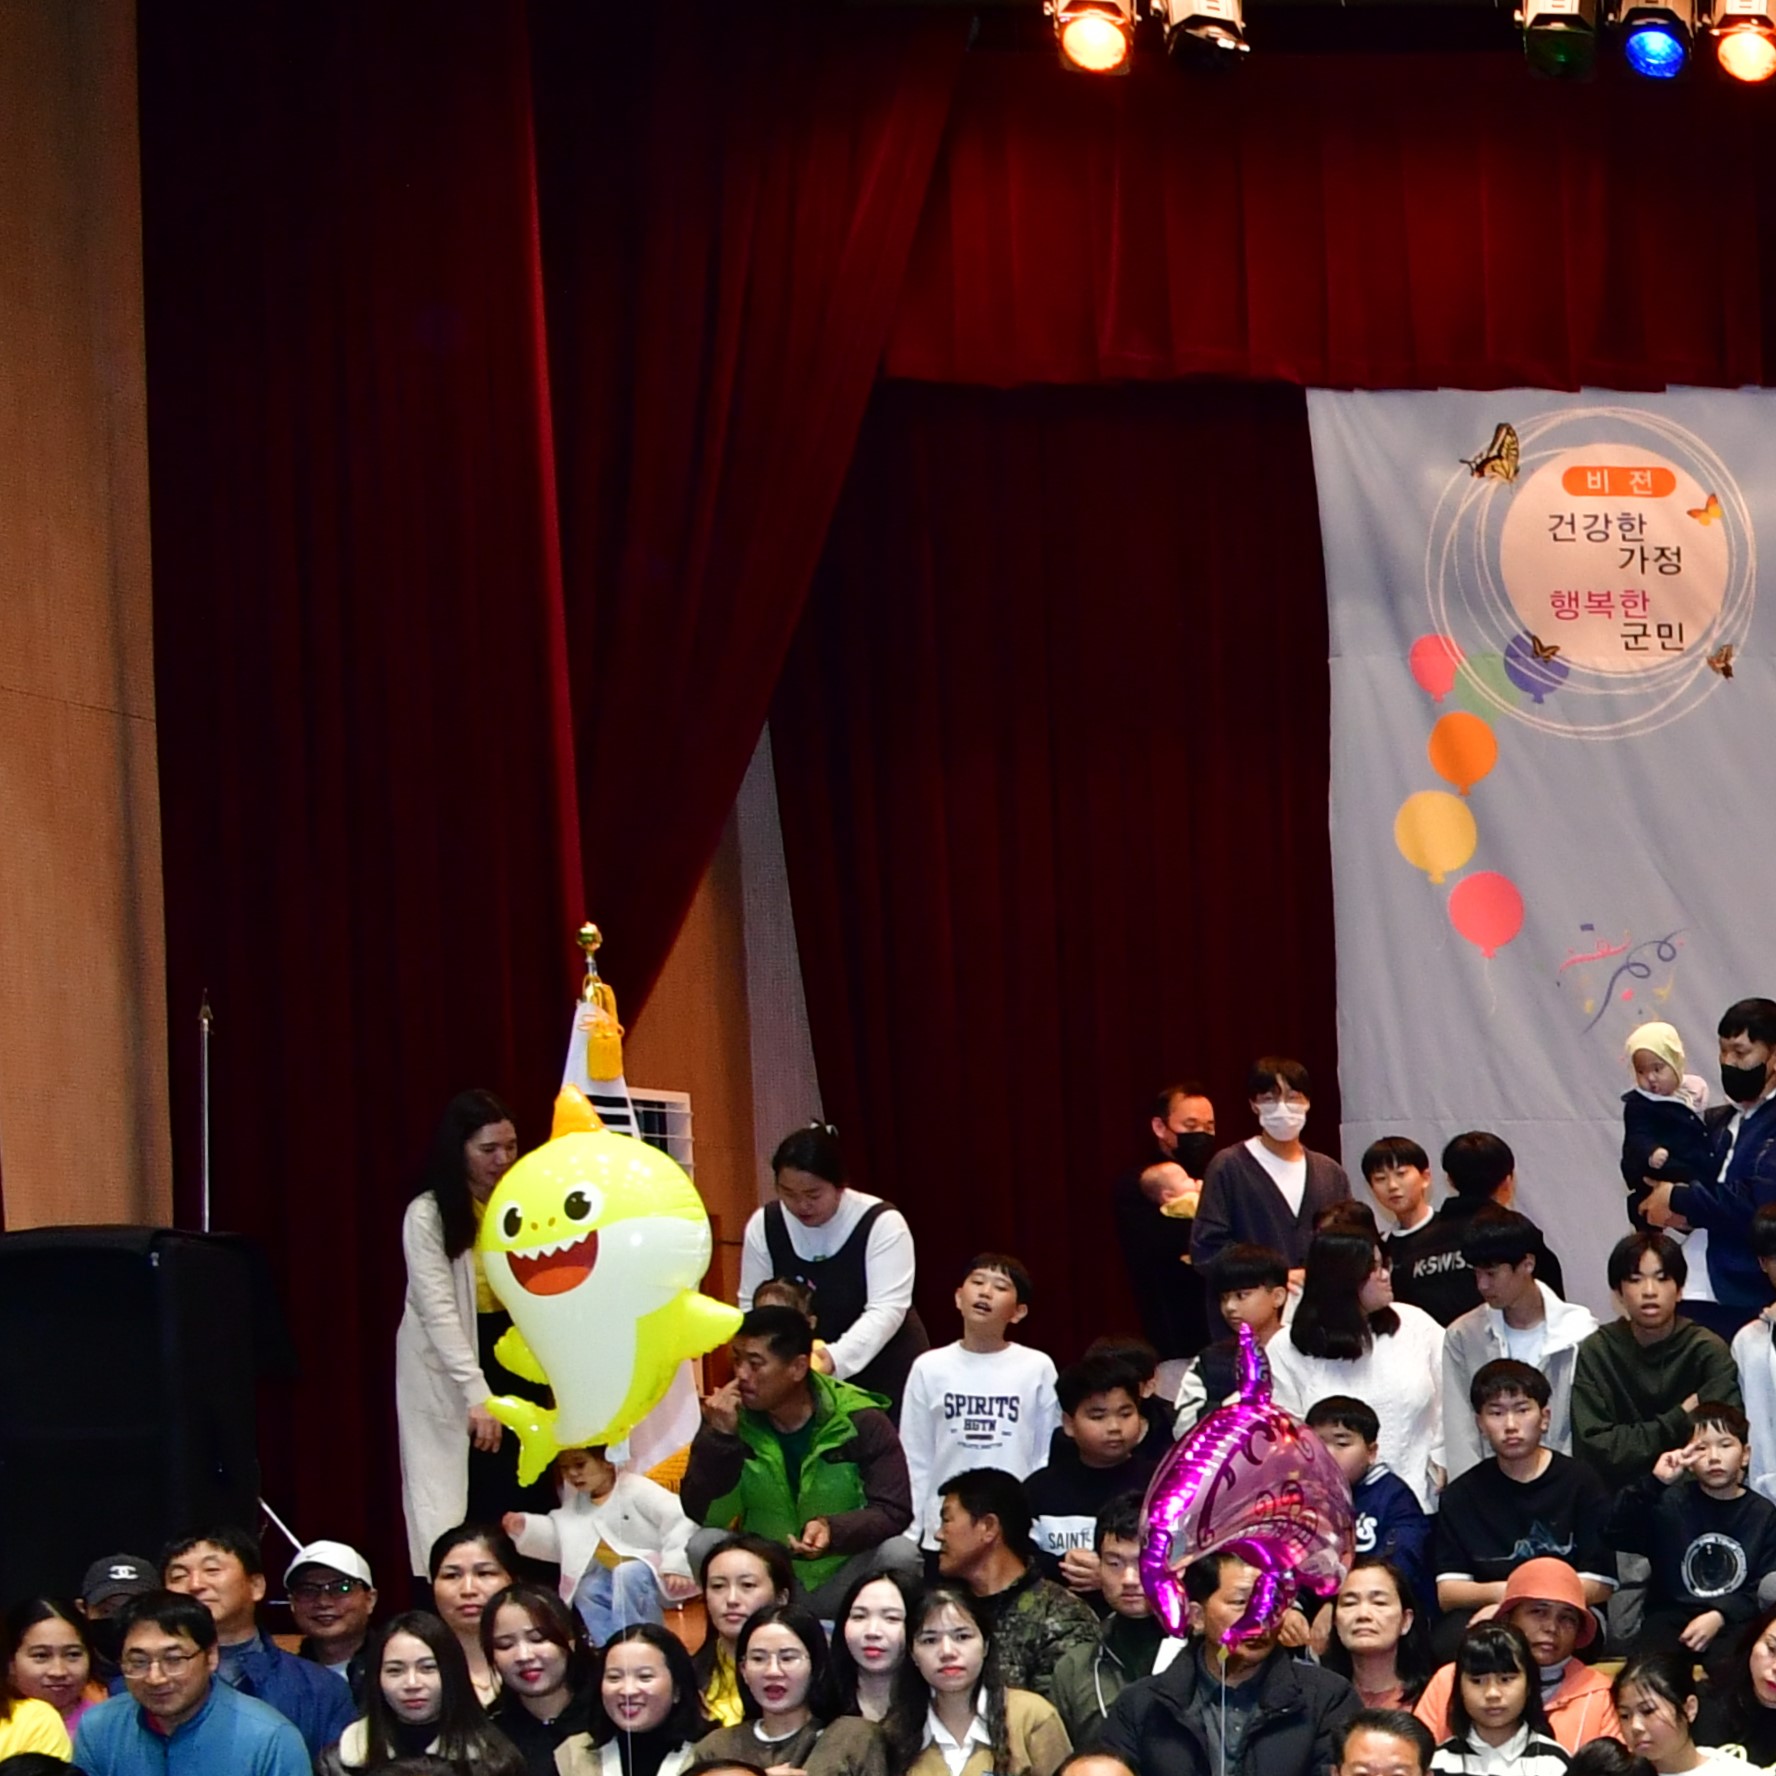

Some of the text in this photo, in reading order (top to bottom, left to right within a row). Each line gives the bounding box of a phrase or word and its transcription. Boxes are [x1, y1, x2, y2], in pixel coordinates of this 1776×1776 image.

[1548, 511, 1648, 543] 건강한
[1618, 545, 1682, 576] 가정
[1549, 589, 1650, 621] 행복한
[1620, 621, 1685, 652] 군민
[943, 1392, 1021, 1424] SPIRITS
